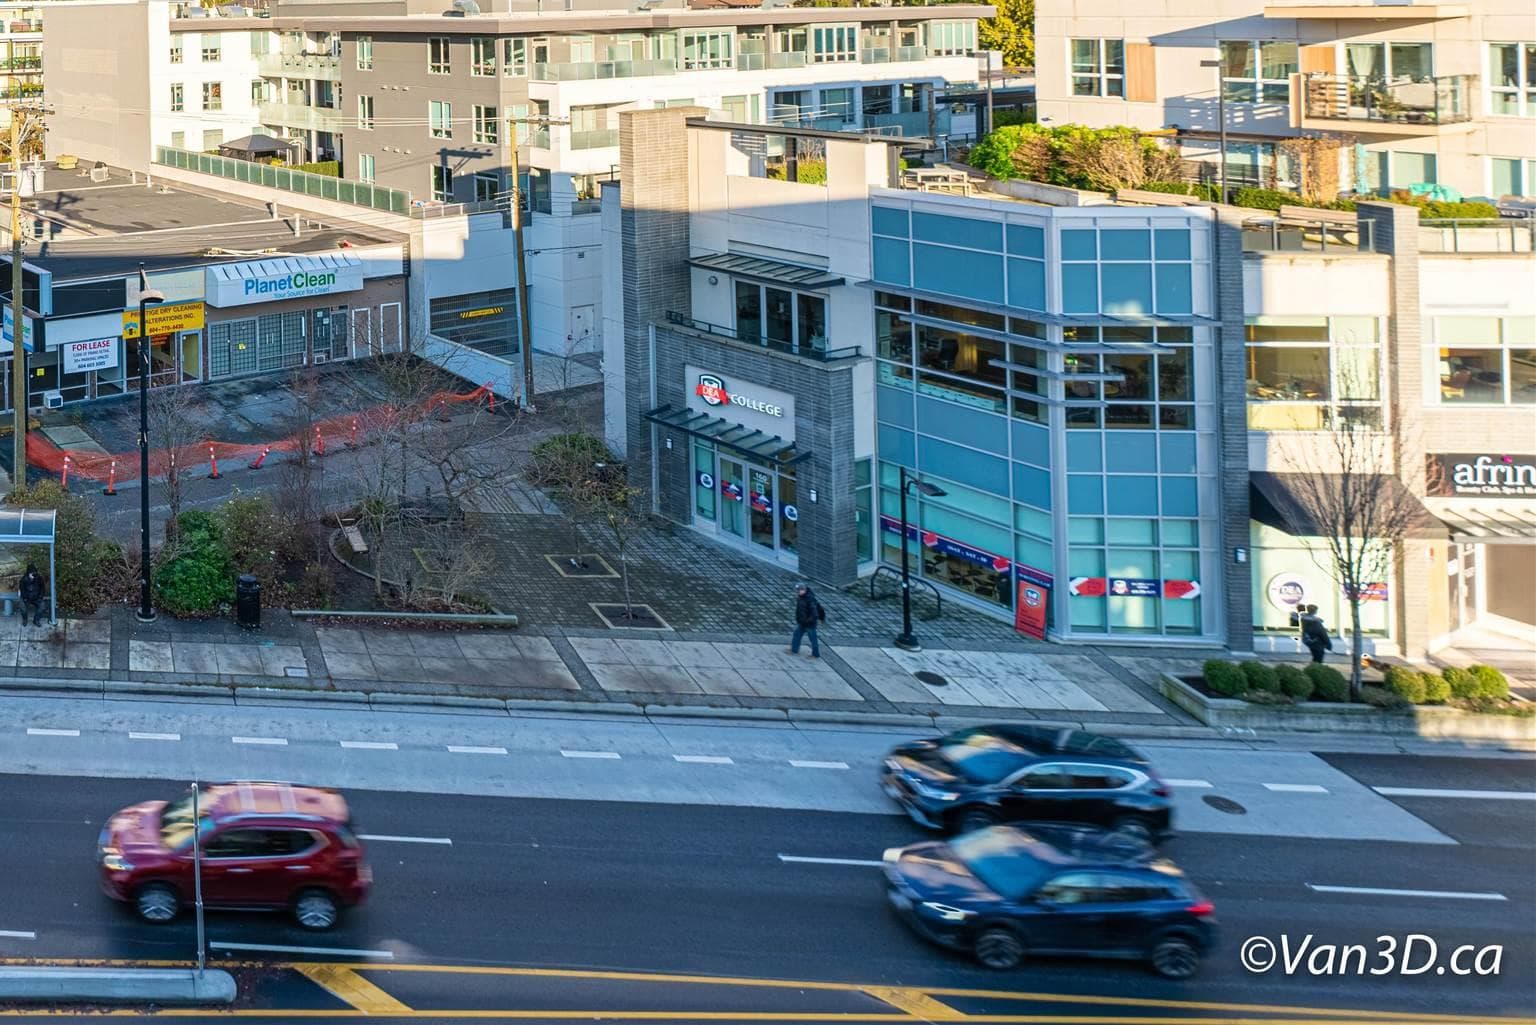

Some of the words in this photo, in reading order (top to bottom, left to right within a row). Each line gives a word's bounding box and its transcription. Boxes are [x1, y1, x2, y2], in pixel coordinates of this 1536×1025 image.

[245, 272, 336, 295] PlanetClean
[287, 290, 306, 298] Source
[172, 304, 202, 312] CLEANING
[72, 343, 88, 352] FOR
[89, 340, 110, 350] LEASE
[730, 394, 782, 417] COLLEGE
[1453, 456, 1536, 486] afrin
